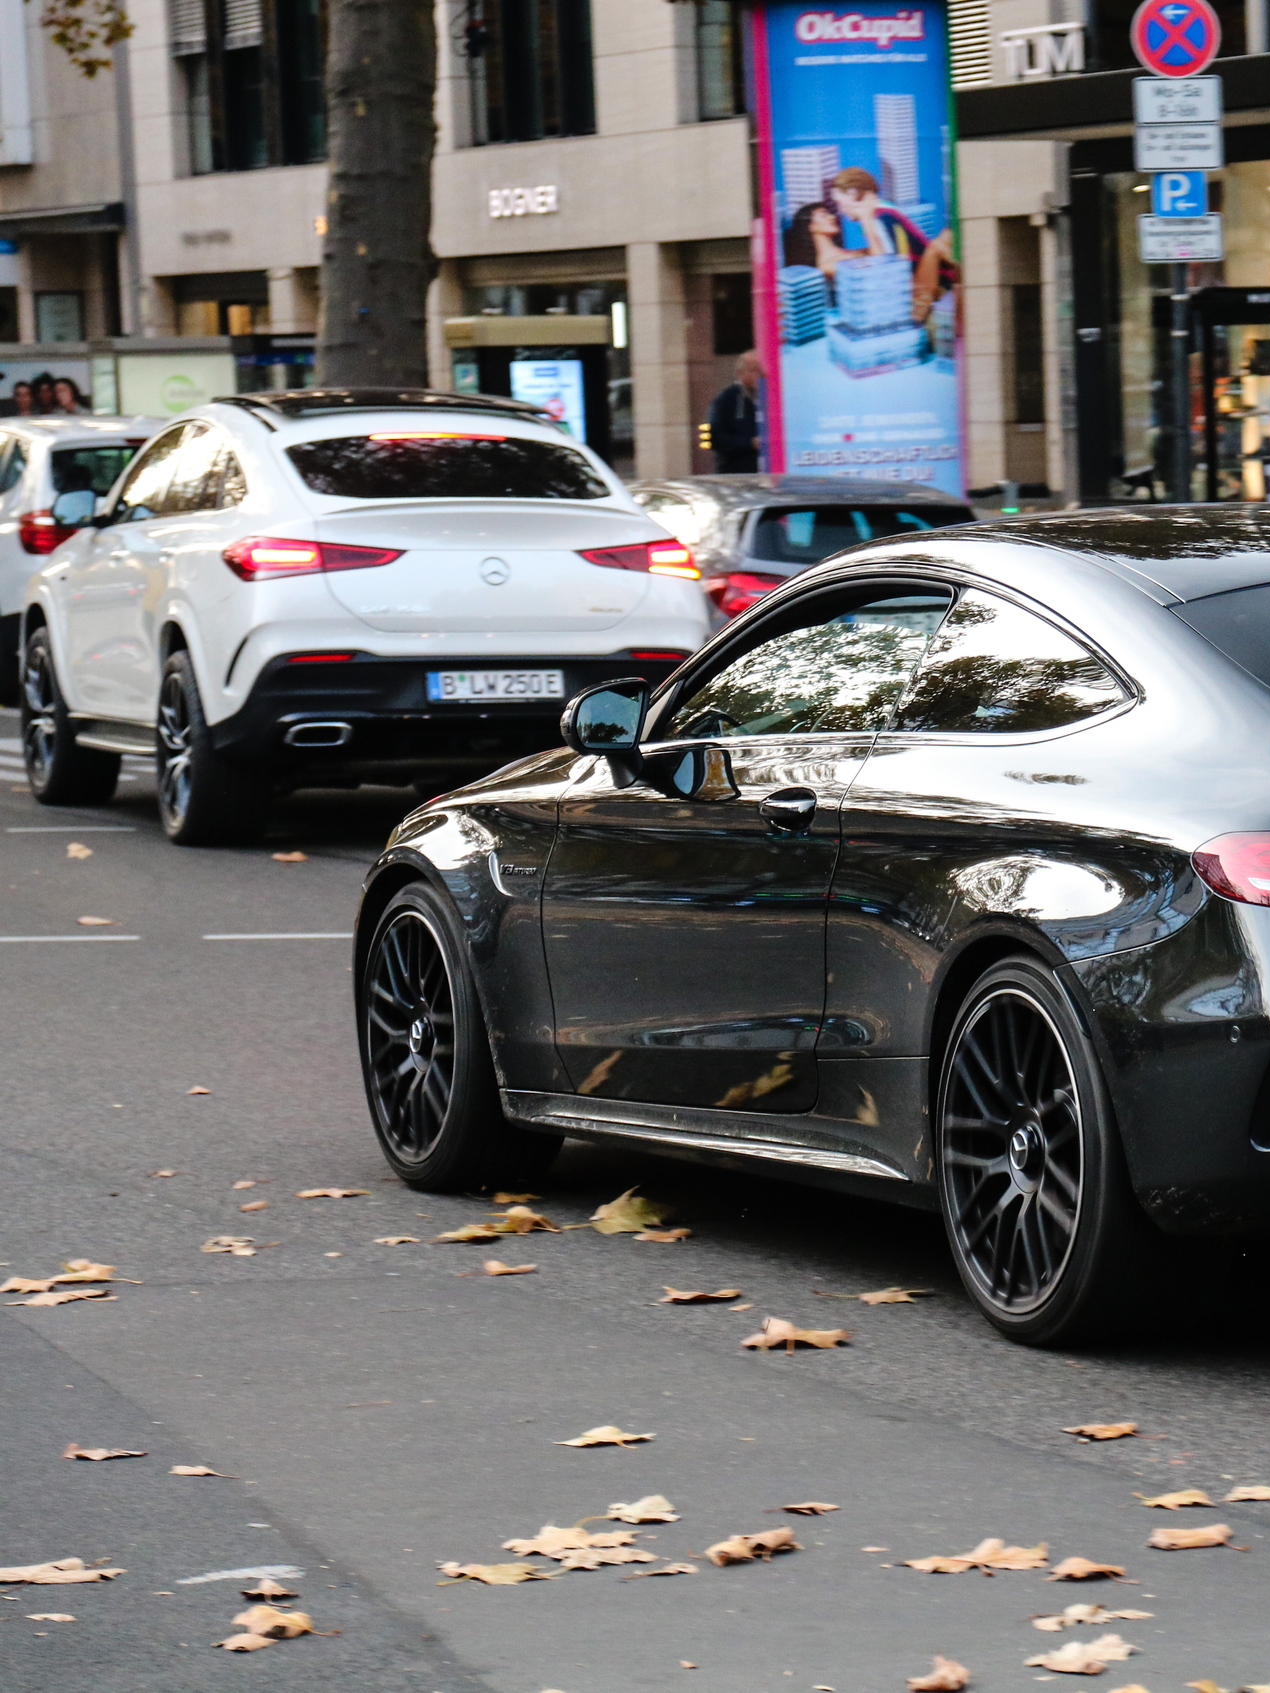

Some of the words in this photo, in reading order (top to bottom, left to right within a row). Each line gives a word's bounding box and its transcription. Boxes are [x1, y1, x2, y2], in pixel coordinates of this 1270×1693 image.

[795, 10, 926, 48] OkCupid
[488, 185, 559, 218] BOGNER
[1160, 173, 1191, 212] P
[443, 674, 456, 695] B
[470, 674, 498, 695] LW
